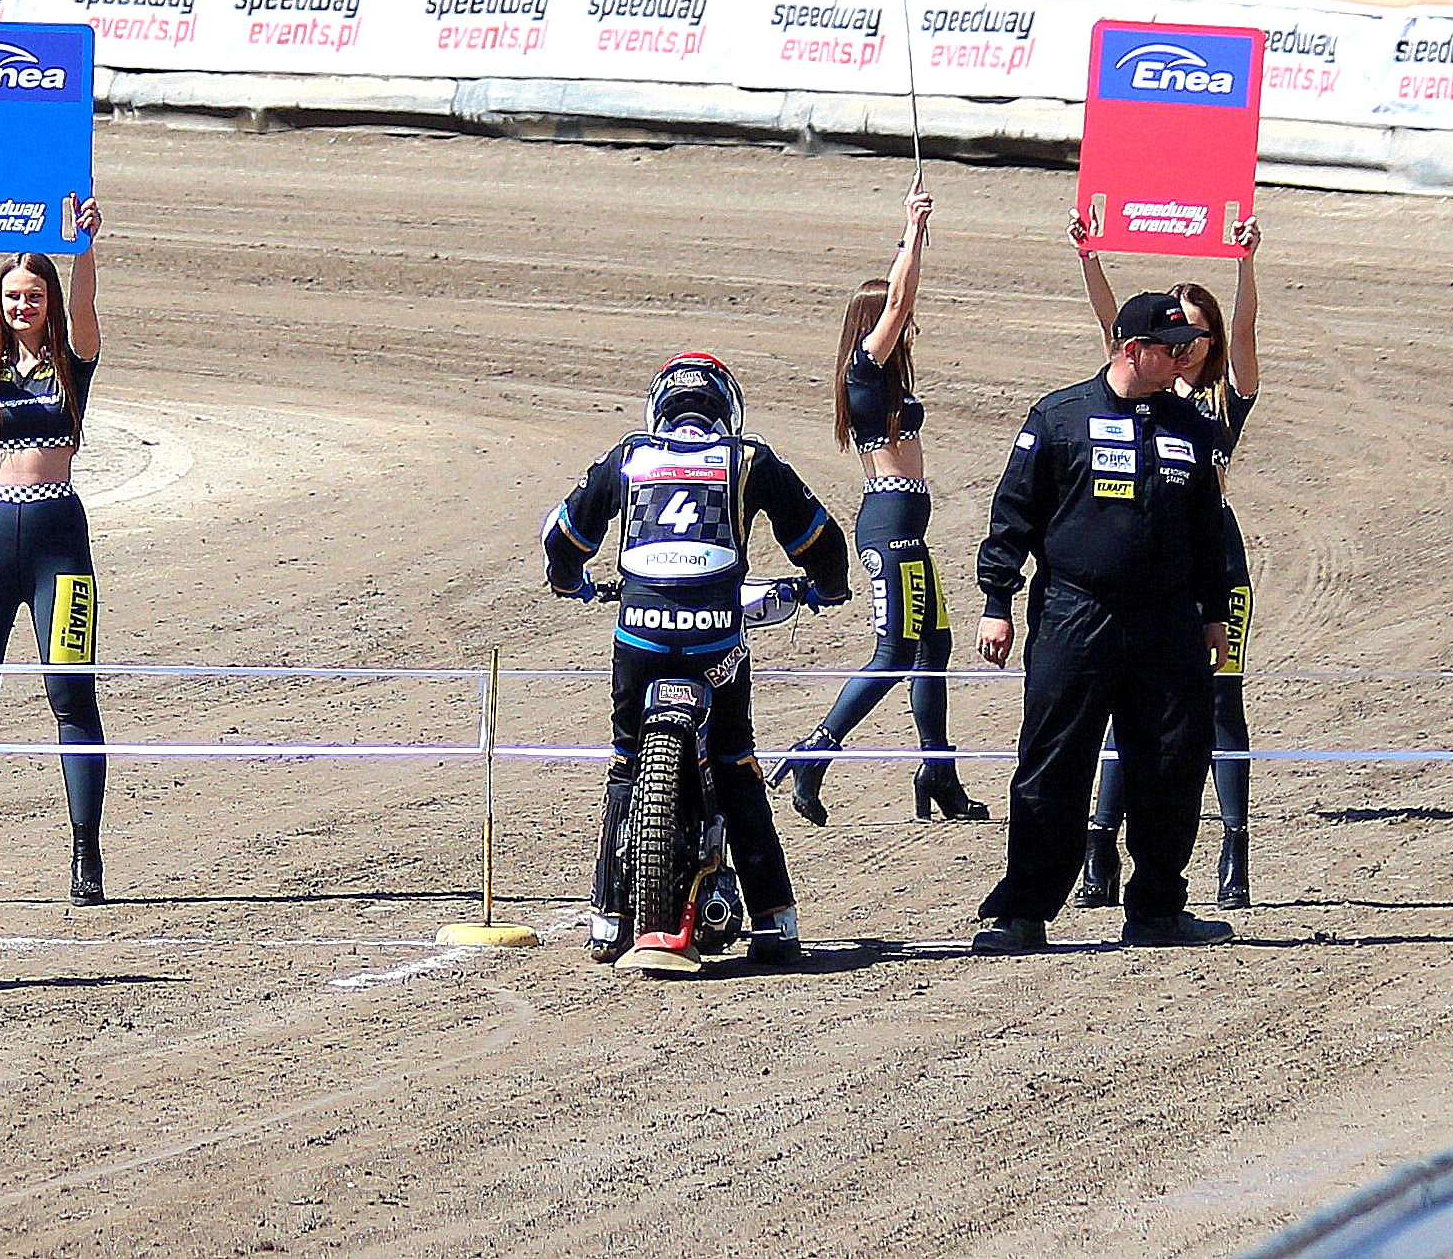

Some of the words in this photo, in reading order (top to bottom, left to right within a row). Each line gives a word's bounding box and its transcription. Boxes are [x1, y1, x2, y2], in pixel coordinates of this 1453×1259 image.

[248, 15, 361, 52] events.pl
[437, 18, 548, 56] events.pl
[922, 3, 1036, 40] speedway
[597, 22, 707, 60] events.pl
[779, 34, 885, 71] events.pl
[930, 36, 1037, 76] events.pl
[1132, 61, 1234, 95] Enea
[1123, 199, 1208, 222] speedway
[1129, 216, 1207, 238] events.pl
[658, 490, 699, 534] 4
[67, 579, 89, 655] ELNAFT
[625, 607, 733, 631] MOLDOW
[910, 570, 925, 635] ELNAFT
